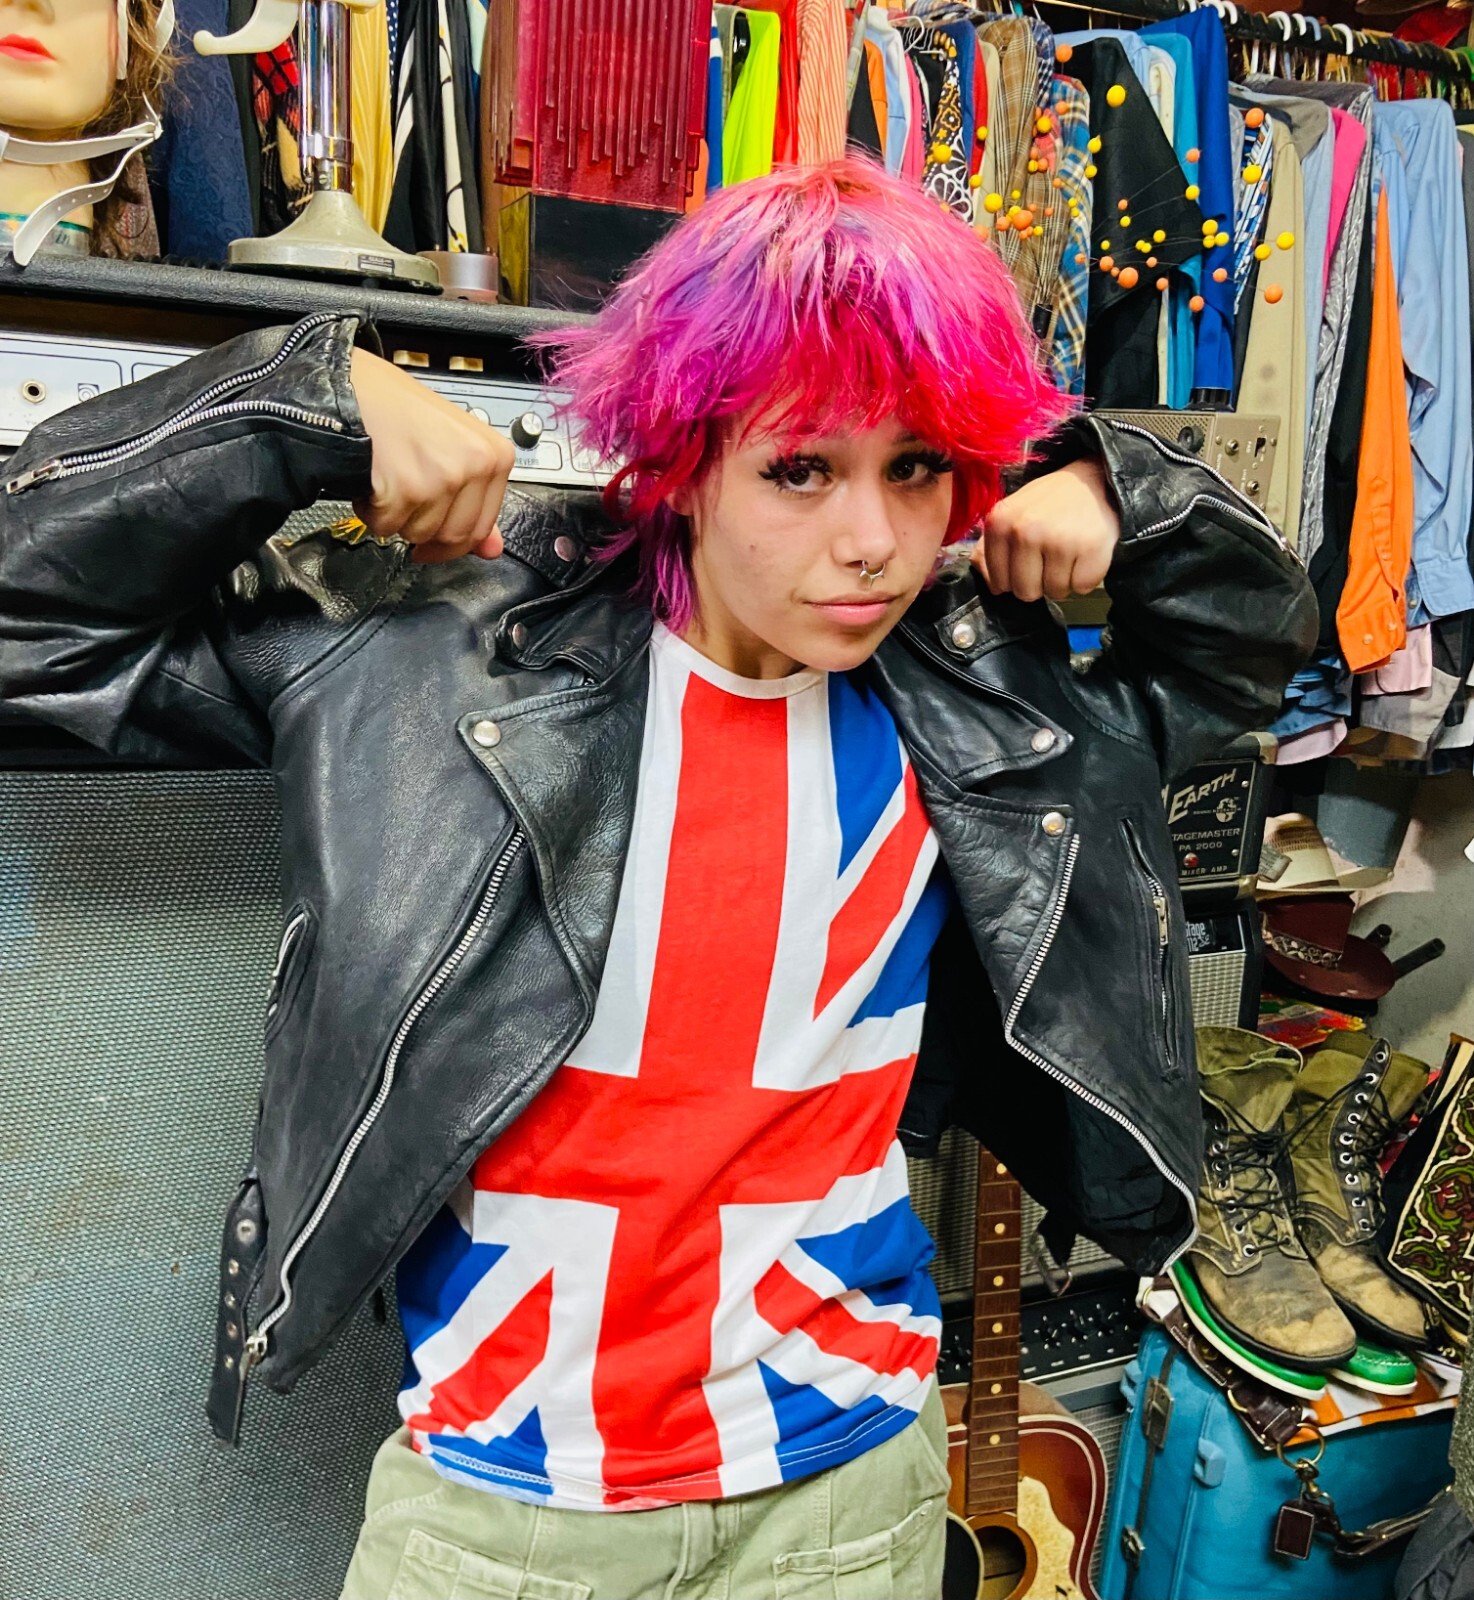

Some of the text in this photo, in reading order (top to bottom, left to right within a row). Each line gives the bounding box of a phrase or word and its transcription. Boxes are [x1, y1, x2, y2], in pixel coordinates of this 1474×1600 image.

[1167, 768, 1237, 825] EARTH
[1171, 827, 1241, 842] TAGEMASTER
[1179, 841, 1223, 851] PA 2000
[1181, 865, 1228, 876] MIXER AMP
